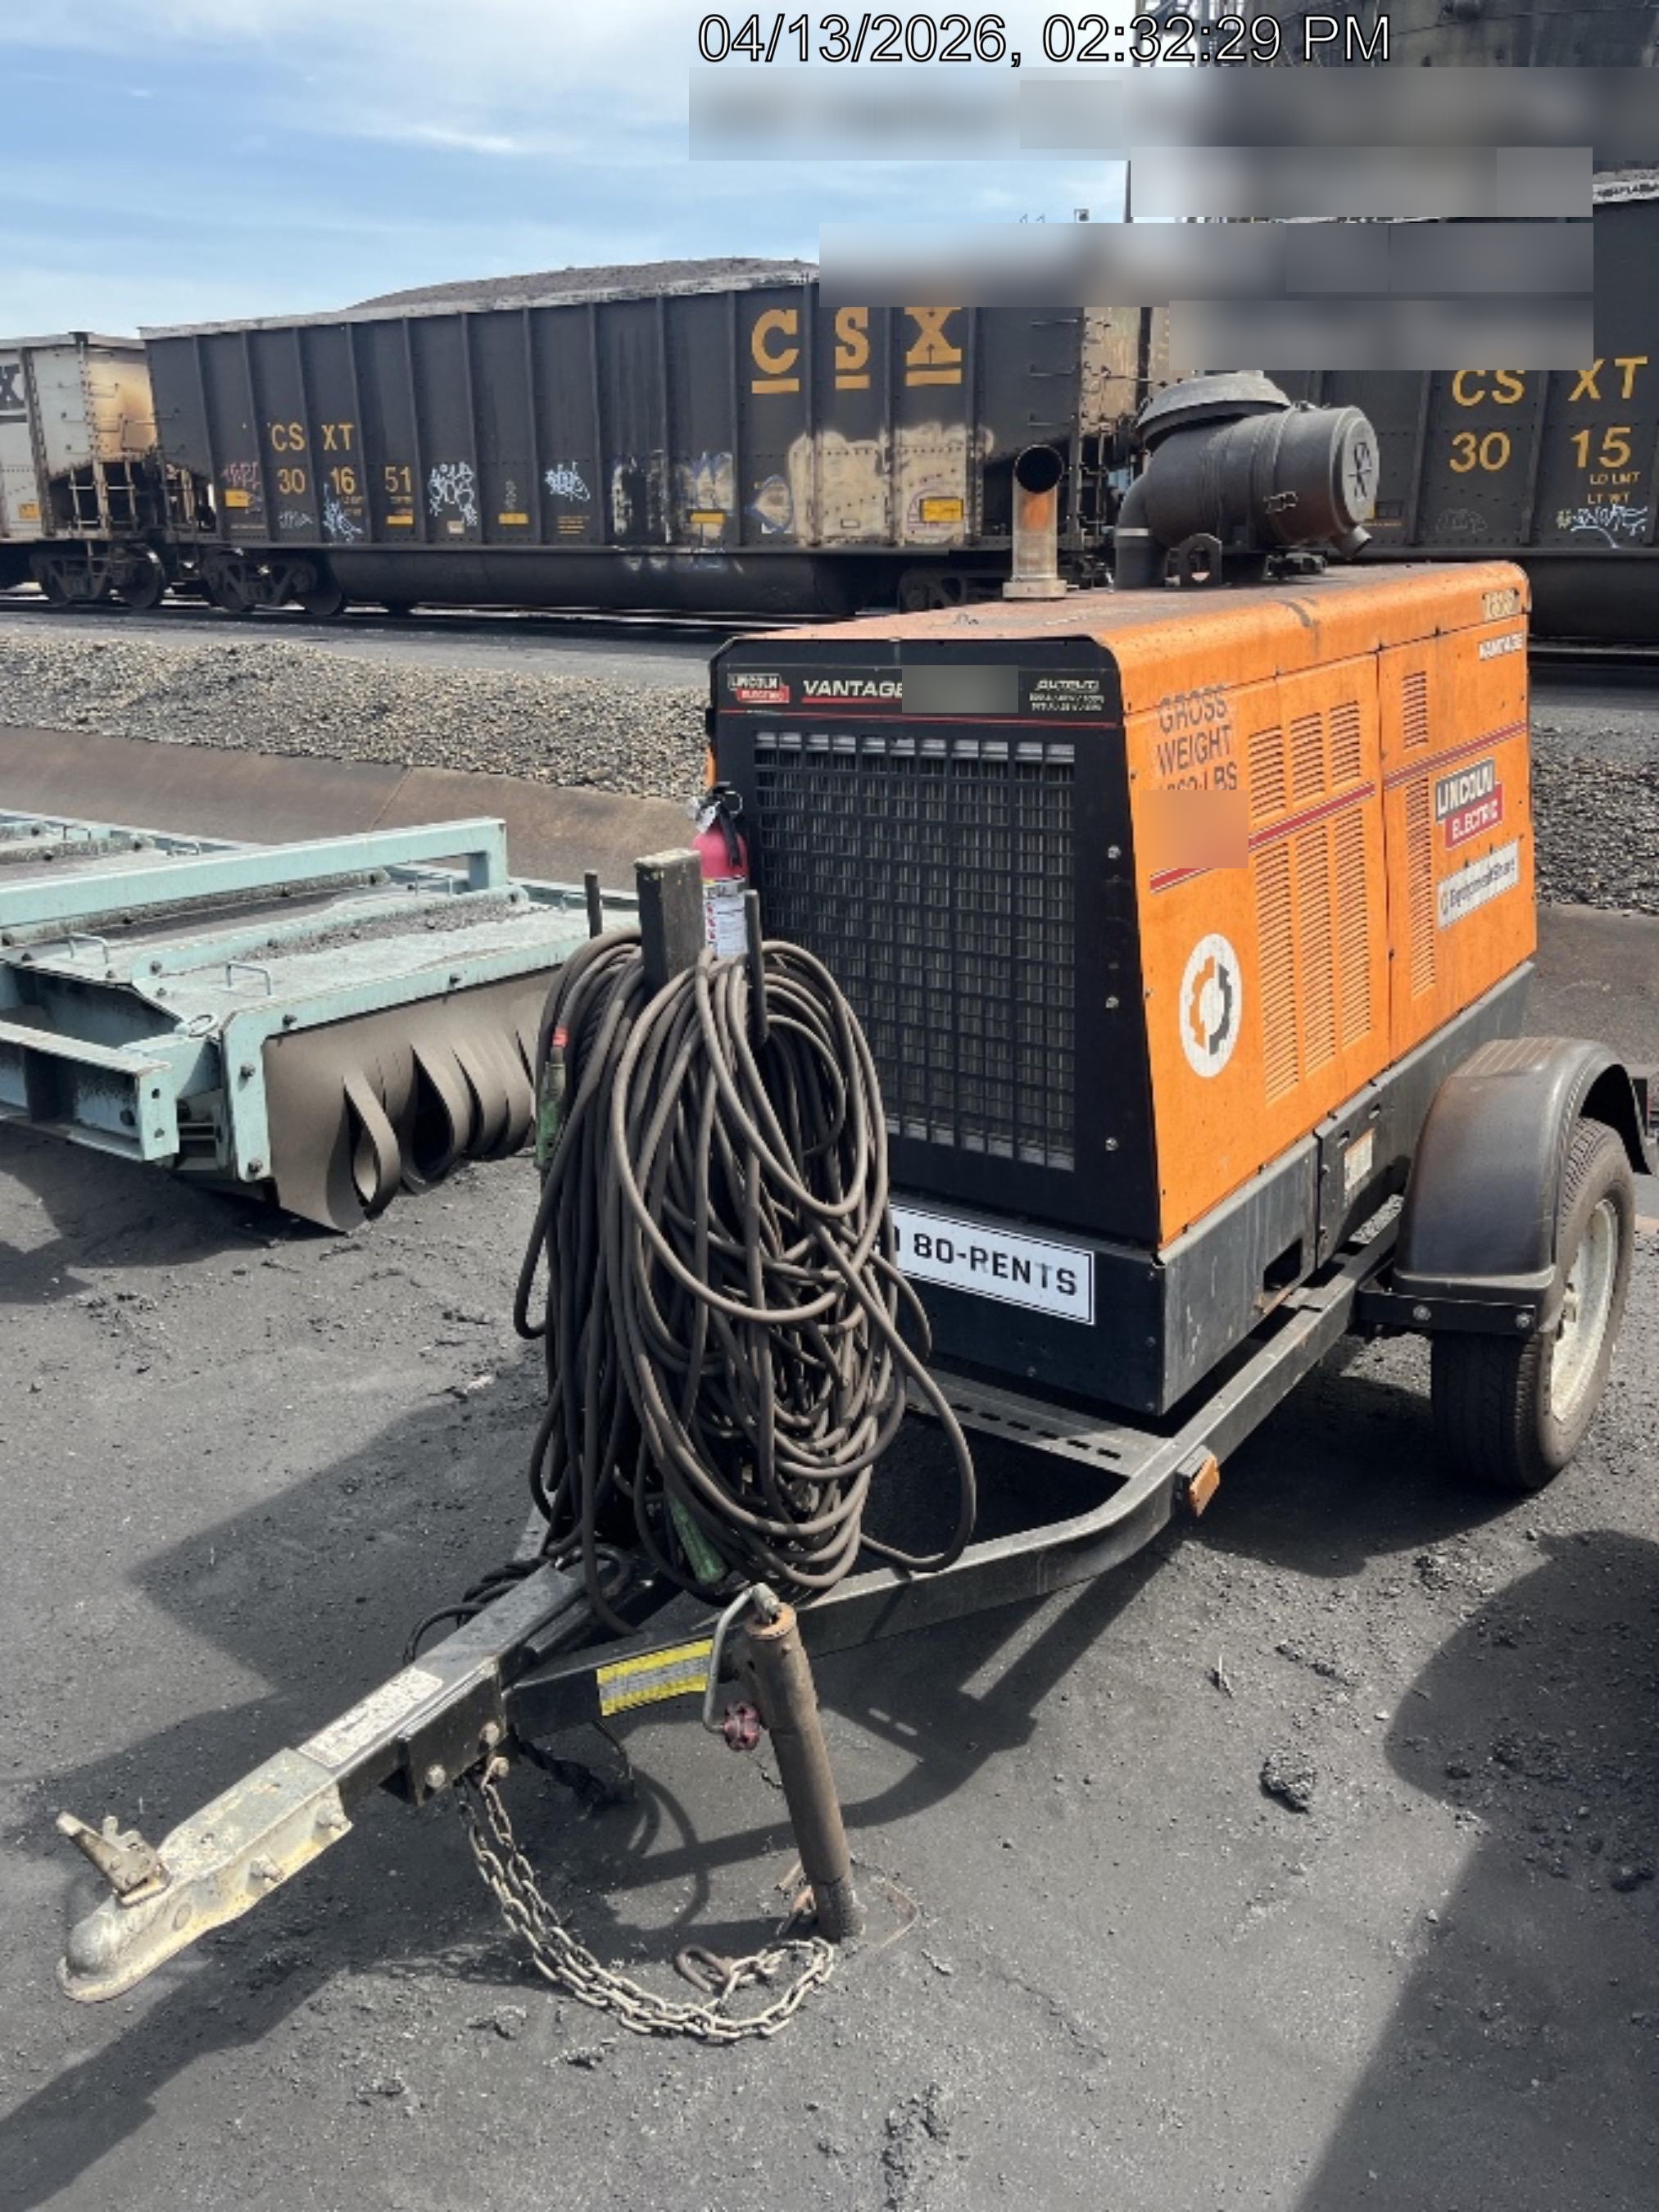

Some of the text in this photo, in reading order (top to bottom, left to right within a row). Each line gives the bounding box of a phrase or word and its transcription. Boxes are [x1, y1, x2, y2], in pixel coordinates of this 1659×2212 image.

[1158, 685, 1228, 734] GROSS
[1157, 725, 1231, 777] WEIGHT
[1438, 764, 1493, 817] LINCOLN
